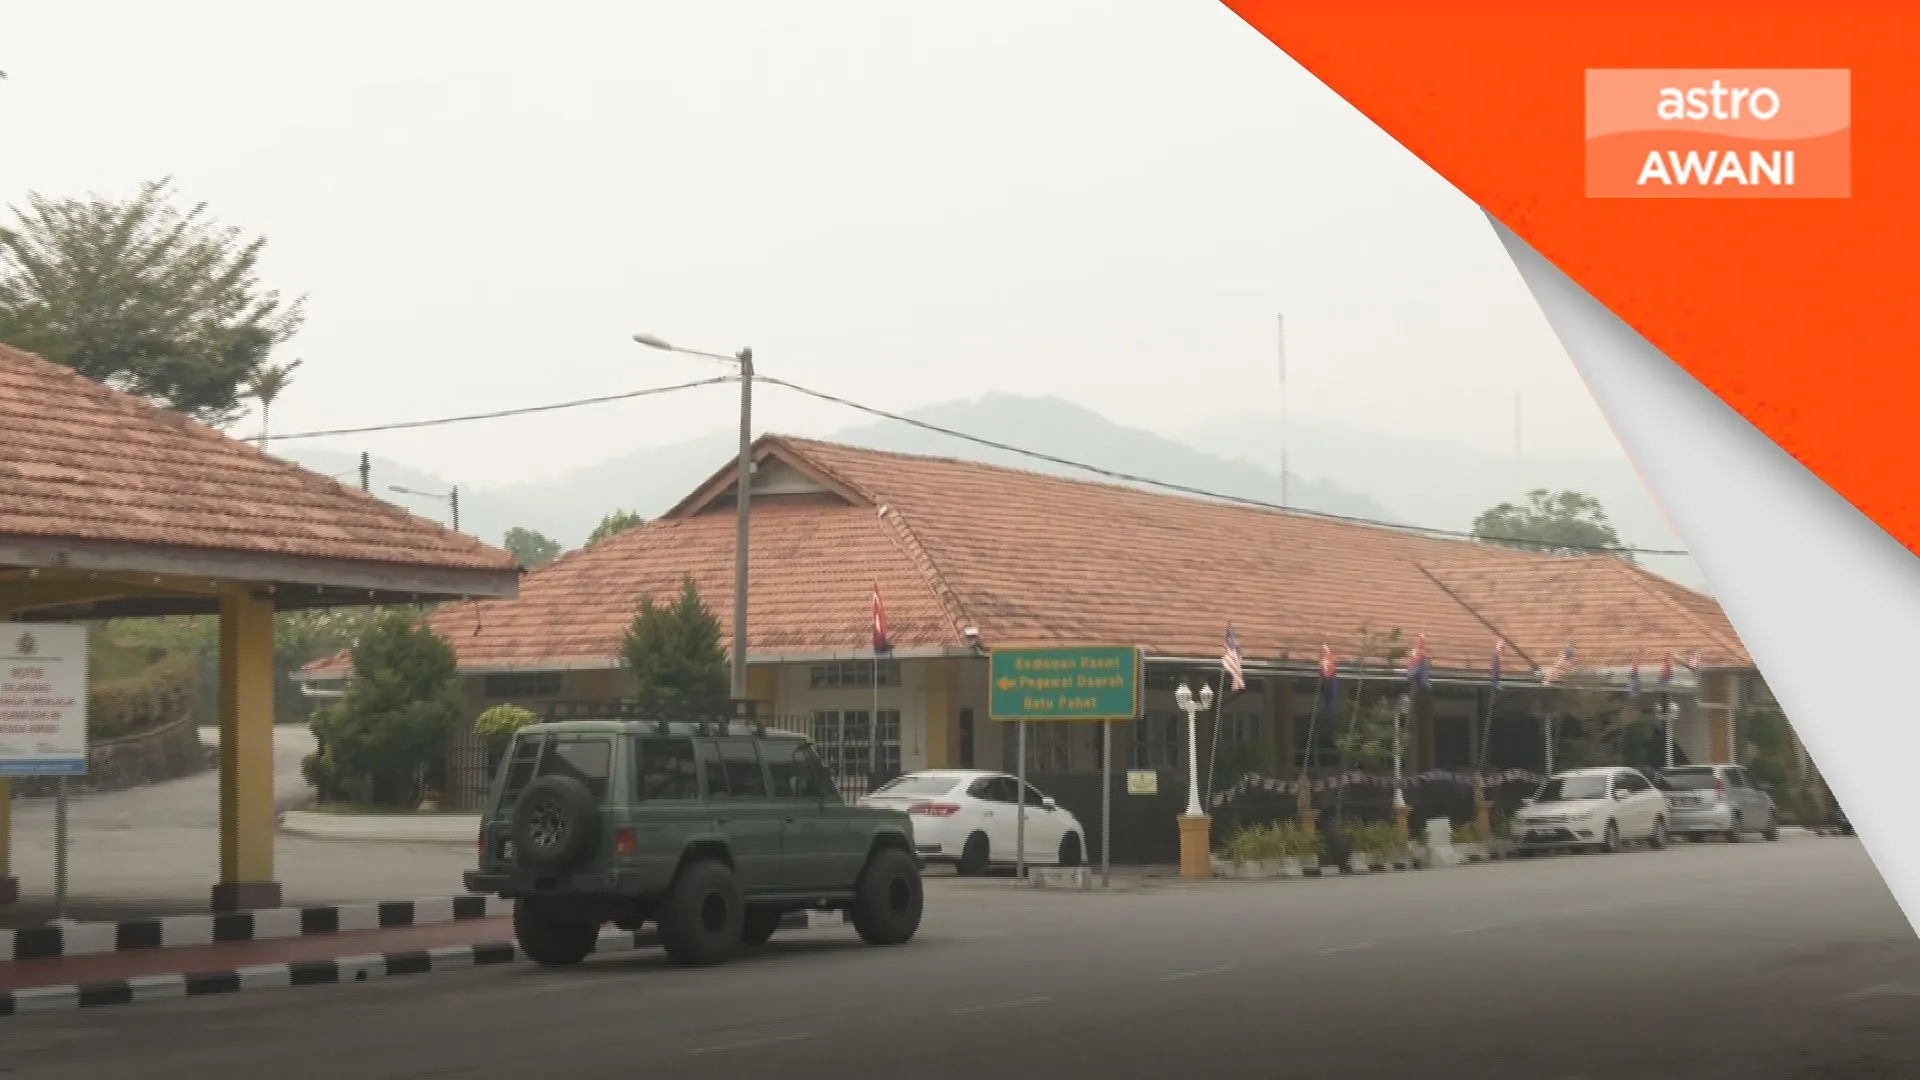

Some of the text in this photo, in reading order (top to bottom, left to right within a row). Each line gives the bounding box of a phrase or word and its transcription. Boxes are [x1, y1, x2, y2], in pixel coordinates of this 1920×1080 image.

[1019, 674, 1124, 690] Pegawai Daerah
[1024, 695, 1097, 710] Batu Pahat
